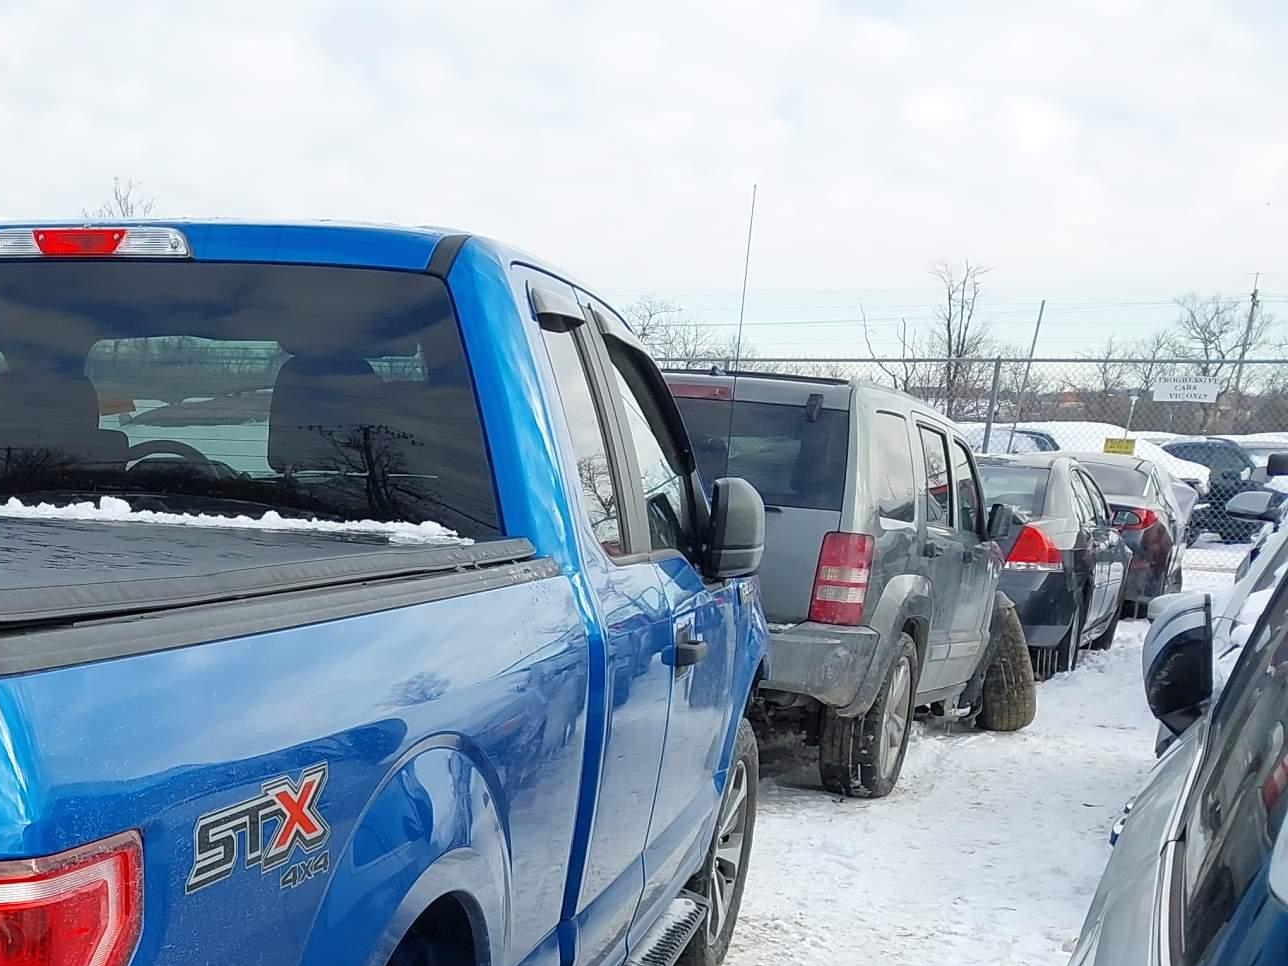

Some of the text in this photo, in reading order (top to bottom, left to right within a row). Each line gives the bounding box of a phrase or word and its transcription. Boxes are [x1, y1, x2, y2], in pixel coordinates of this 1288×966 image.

[1174, 384, 1198, 392] CARS
[1185, 392, 1209, 400] ONLY
[185, 759, 330, 895] STX
